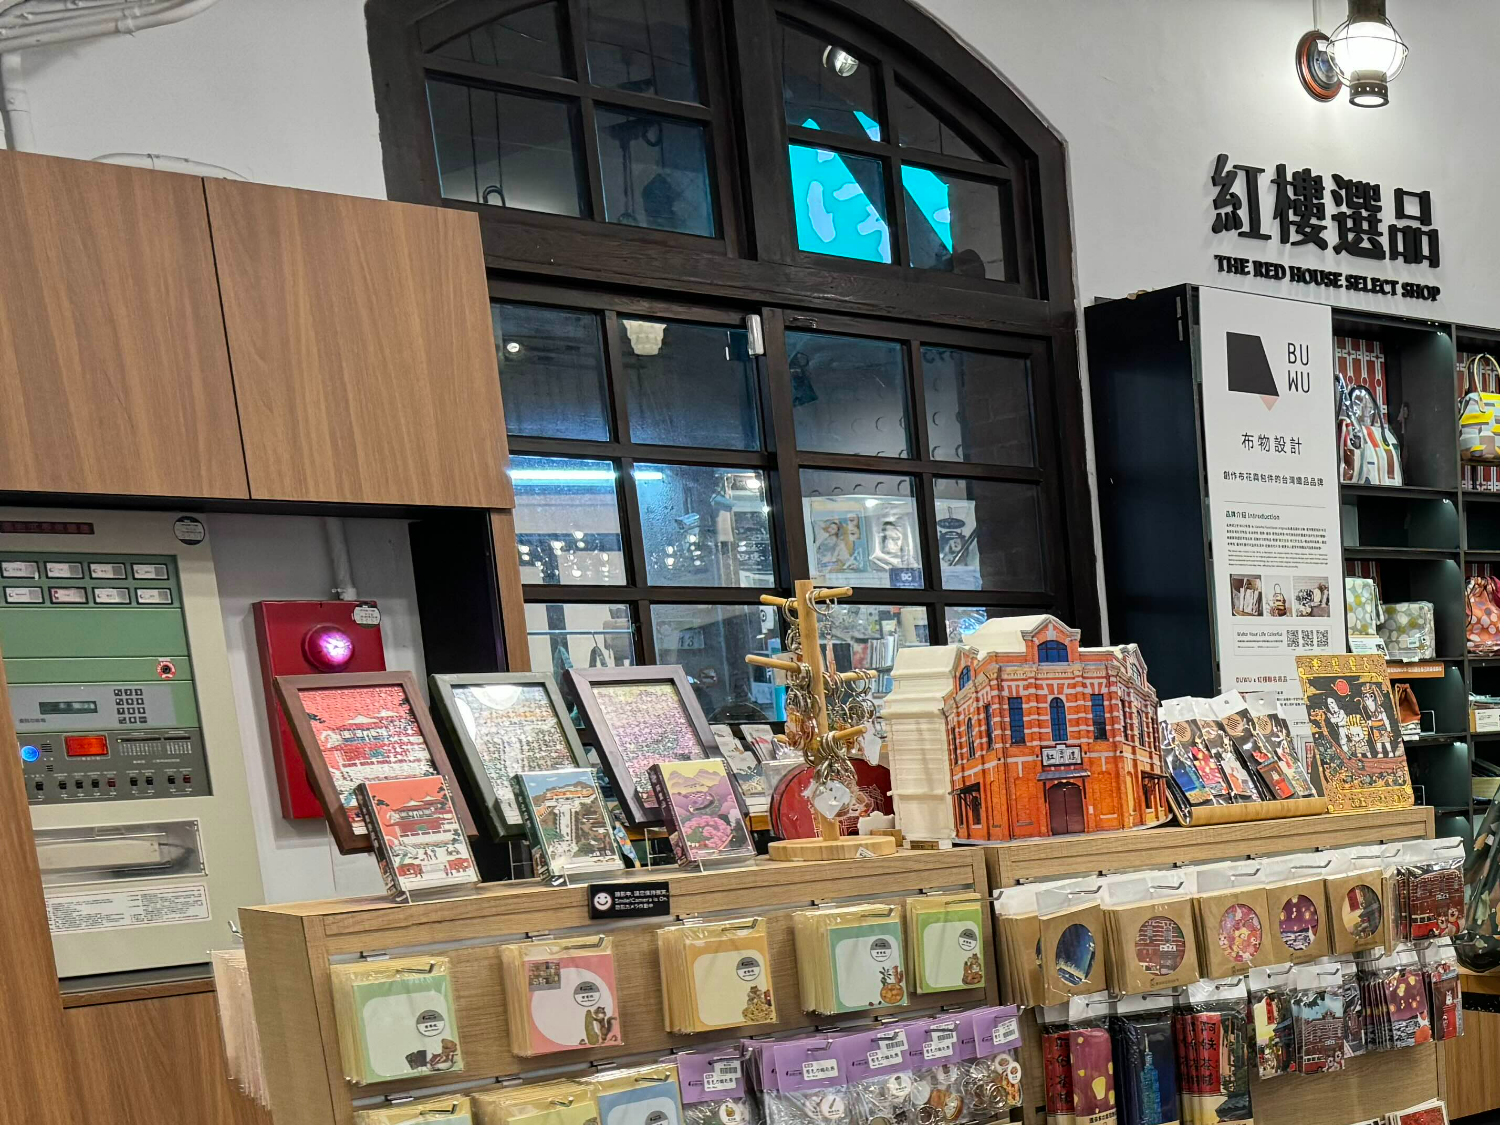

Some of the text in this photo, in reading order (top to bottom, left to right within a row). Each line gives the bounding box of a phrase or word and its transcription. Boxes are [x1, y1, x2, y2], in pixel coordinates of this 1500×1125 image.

[1211, 153, 1441, 269] 紅樓選品
[1214, 254, 1441, 302] THE RED HOUSE SELECT SHOP
[1287, 342, 1310, 366] BU
[1287, 369, 1311, 394] WU
[1241, 432, 1303, 456] 布物設計
